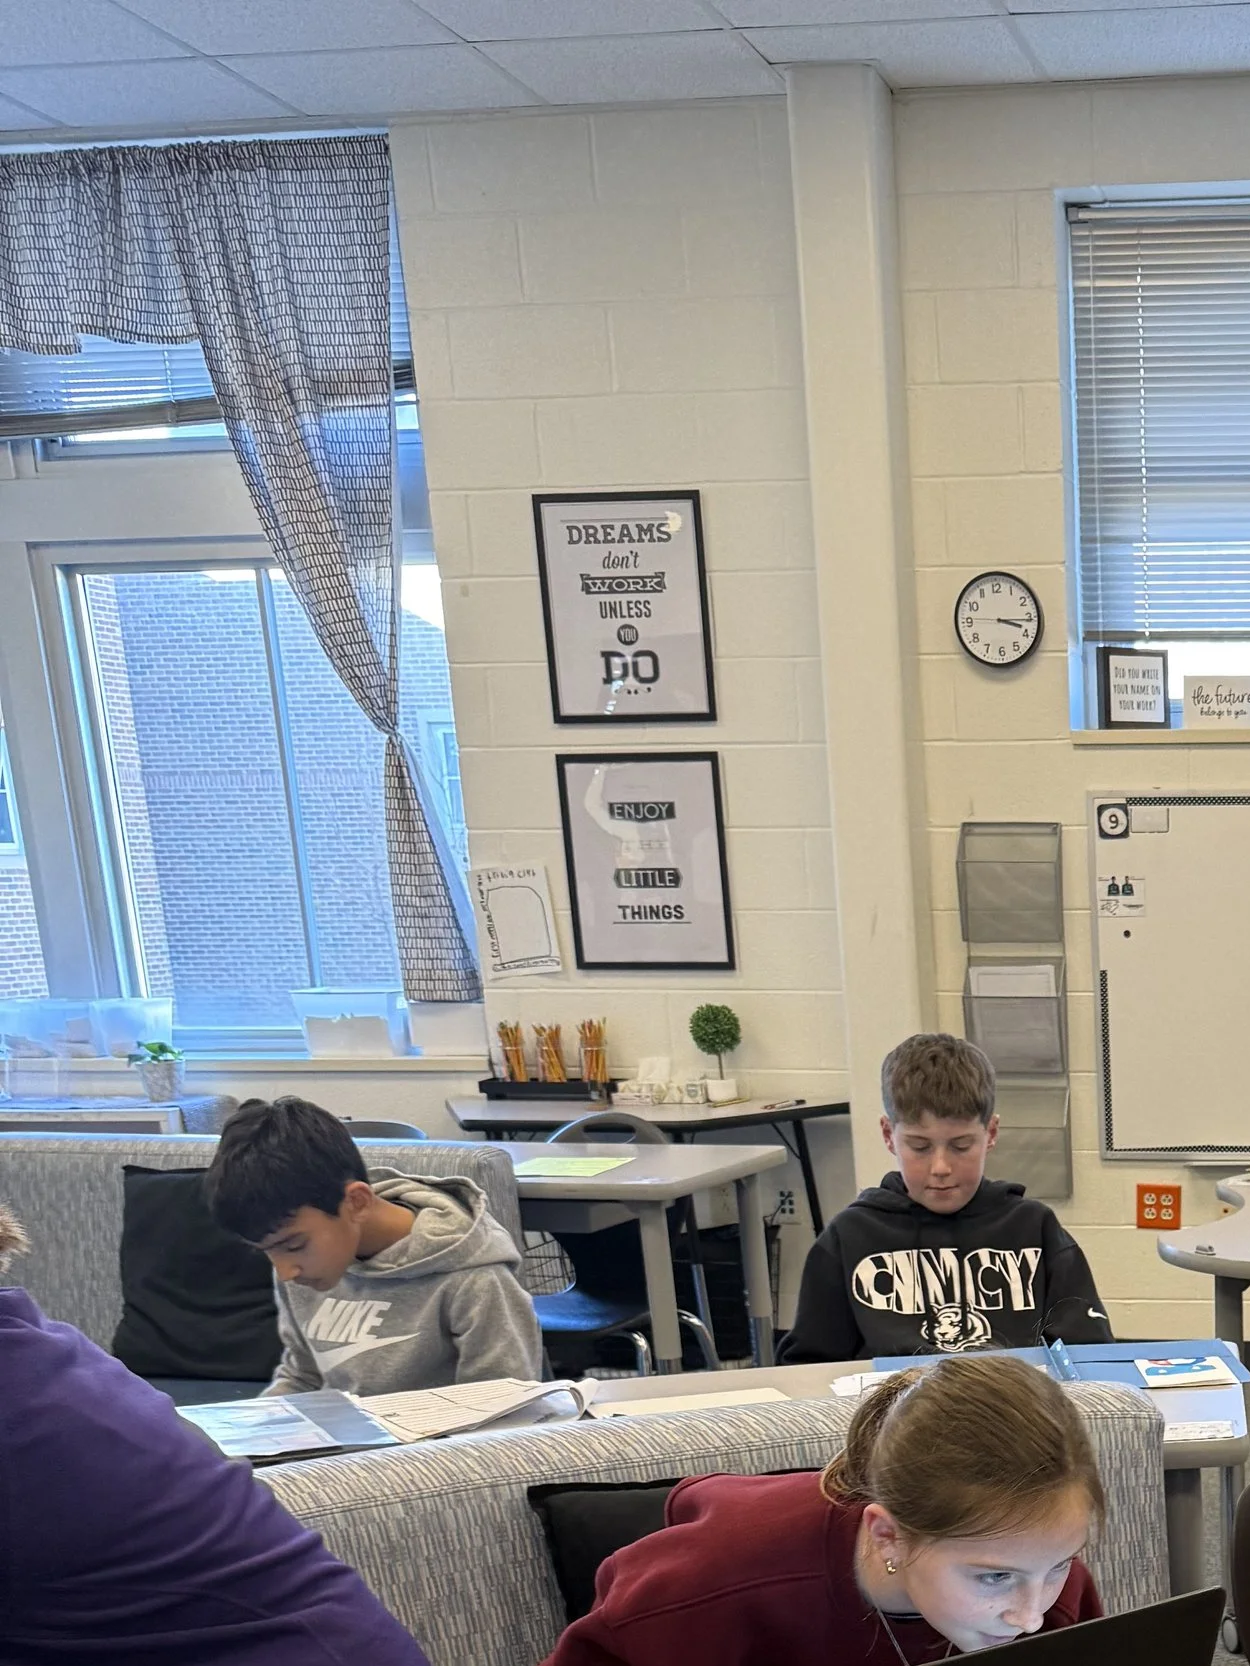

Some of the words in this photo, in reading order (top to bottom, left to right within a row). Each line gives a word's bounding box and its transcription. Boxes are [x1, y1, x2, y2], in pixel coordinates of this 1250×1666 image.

[566, 523, 672, 545] DREAMS
[602, 551, 639, 569] don't
[588, 577, 663, 592] WORK
[992, 583, 1002, 594] 12
[968, 601, 979, 612] 10
[1019, 596, 1027, 607] 2
[599, 600, 652, 619] UNLESS
[965, 616, 974, 628] 9
[1025, 612, 1033, 622] 3
[619, 627, 637, 642] YOU
[972, 632, 980, 643] 8
[1022, 628, 1030, 639] 4
[984, 643, 991, 654] 7
[998, 646, 1006, 657] 6
[1012, 641, 1020, 652] 5
[600, 650, 660, 685] DO
[1114, 666, 1126, 678] DID
[1128, 668, 1140, 679] YOU
[1113, 683, 1129, 695] YOUR
[1130, 684, 1149, 696] NAME
[1191, 685, 1213, 706] the
[1119, 700, 1135, 711] YOUR
[613, 803, 669, 819] ENJOY
[1108, 813, 1119, 830] 9
[620, 870, 676, 887] LITTLE
[617, 904, 685, 921] THINGS
[851, 1247, 1042, 1315] CINCY
[306, 1297, 393, 1344] NIKE
